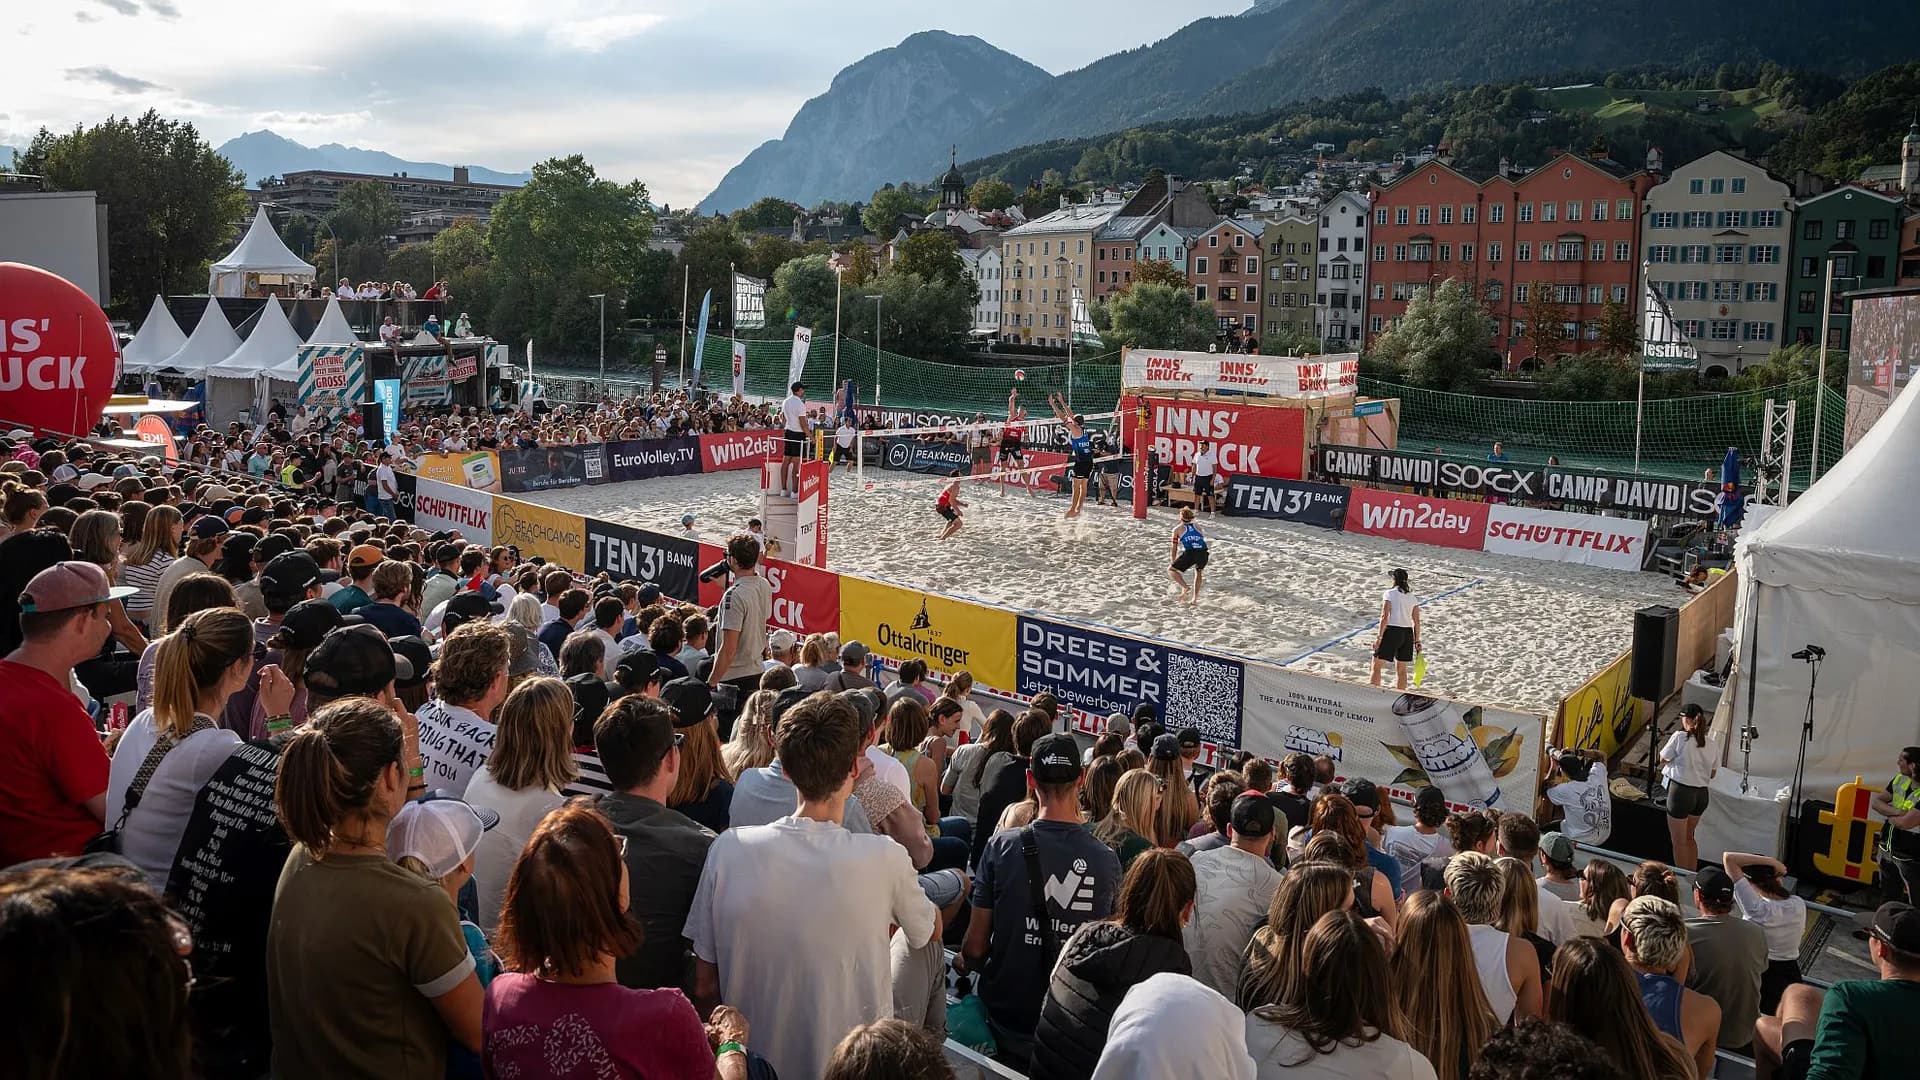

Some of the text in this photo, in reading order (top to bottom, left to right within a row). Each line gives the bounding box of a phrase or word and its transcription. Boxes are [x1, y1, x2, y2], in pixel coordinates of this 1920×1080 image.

[1146, 369, 1193, 382] BRUCK
[1220, 361, 1258, 376] INNS'
[1155, 406, 1239, 439] INNS'
[614, 447, 694, 467] EuroVolley.TV
[916, 449, 971, 465] PEAKMEDIA
[1380, 455, 1432, 483] DAVID
[1314, 492, 1343, 504] BANK
[1549, 473, 1608, 503] CAMP
[1615, 479, 1680, 511] DAVID
[416, 495, 488, 530] SCHÜTTFLIX
[515, 519, 581, 549] BEACHCAMPS
[1488, 520, 1637, 554] SCHÜTTFLIX
[667, 551, 695, 569] BANK
[878, 622, 970, 667] Ottakringer
[1022, 621, 1162, 674] DREES &
[1022, 650, 1159, 703] SOMMER
[1022, 675, 1053, 693] Jetzt
[1058, 683, 1131, 716] bewerben!
[1260, 694, 1374, 723] THE AUSTRIAN KISS OF LEMON
[1288, 691, 1342, 708] 100% NATURAL
[1288, 724, 1330, 746] SODA
[445, 738, 487, 769] THAT
